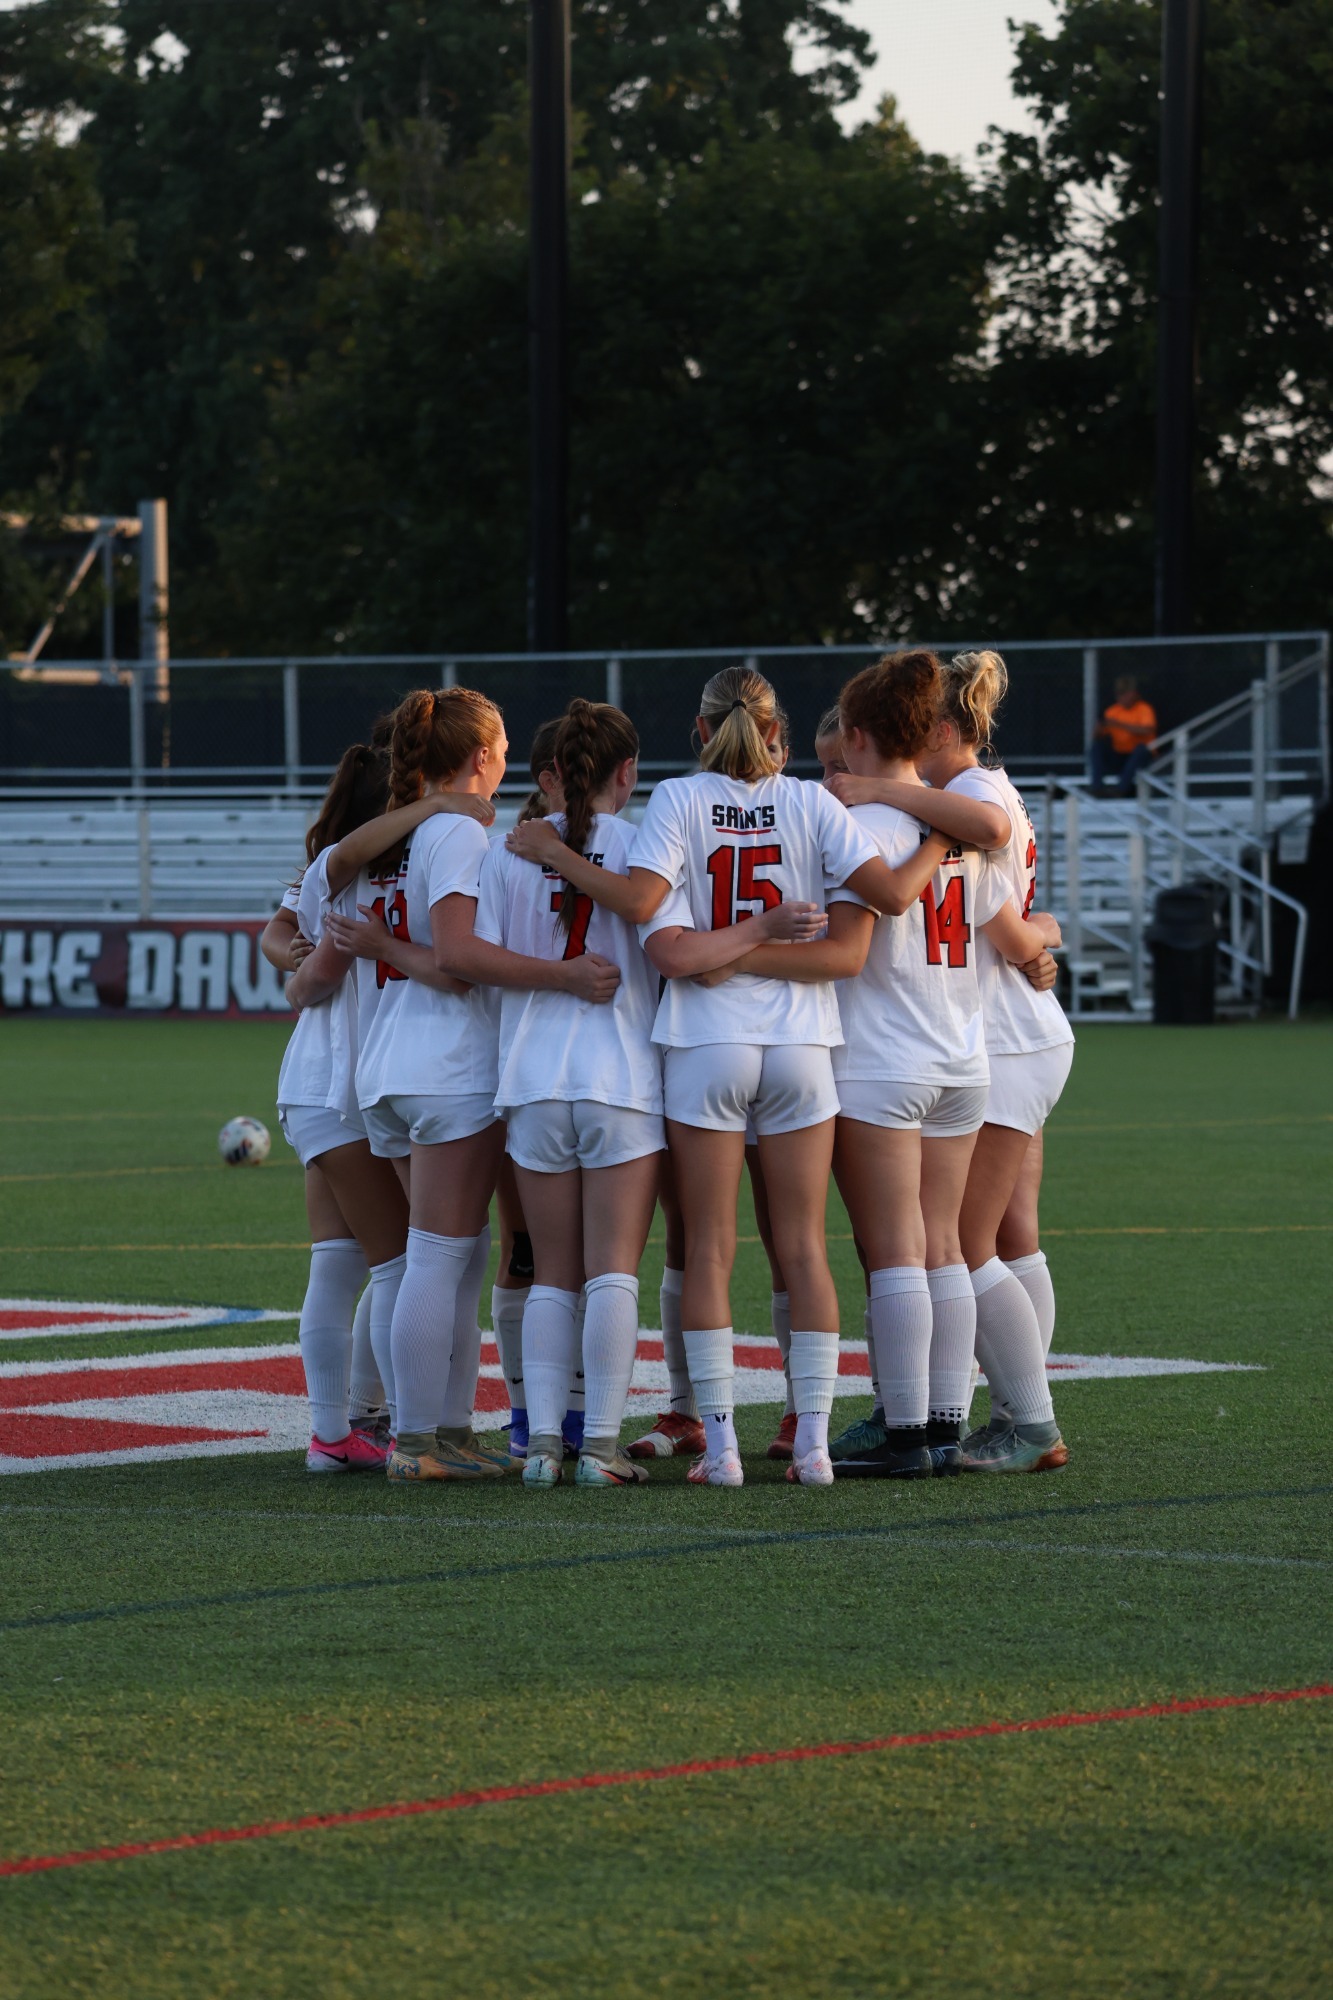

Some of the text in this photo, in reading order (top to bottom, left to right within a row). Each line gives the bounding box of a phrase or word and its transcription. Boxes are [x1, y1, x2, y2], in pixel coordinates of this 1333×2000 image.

[550, 892, 594, 960] 7
[707, 844, 783, 930] 15
[919, 875, 970, 968] 14
[0, 930, 102, 1008] HE
